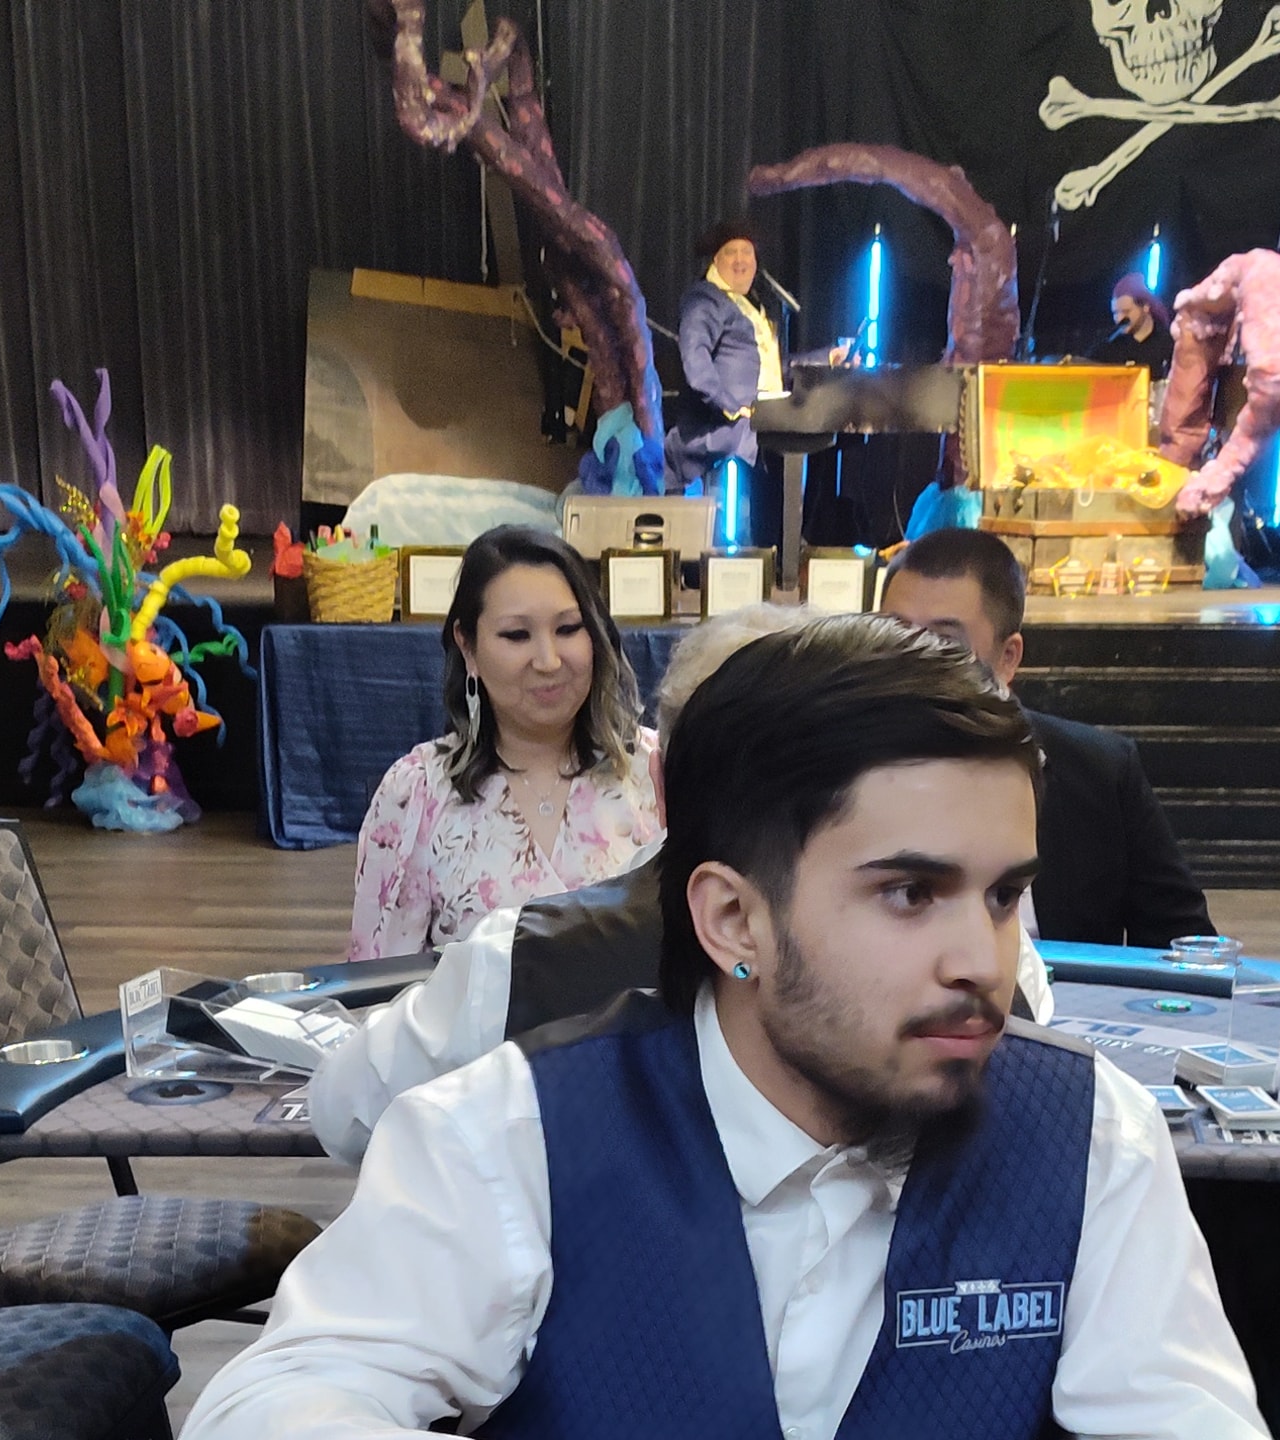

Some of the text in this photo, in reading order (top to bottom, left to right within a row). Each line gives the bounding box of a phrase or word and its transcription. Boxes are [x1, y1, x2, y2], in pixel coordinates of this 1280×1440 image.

[901, 1290, 1058, 1338] BLUE LABEL
[949, 1330, 1007, 1355] Casinos
